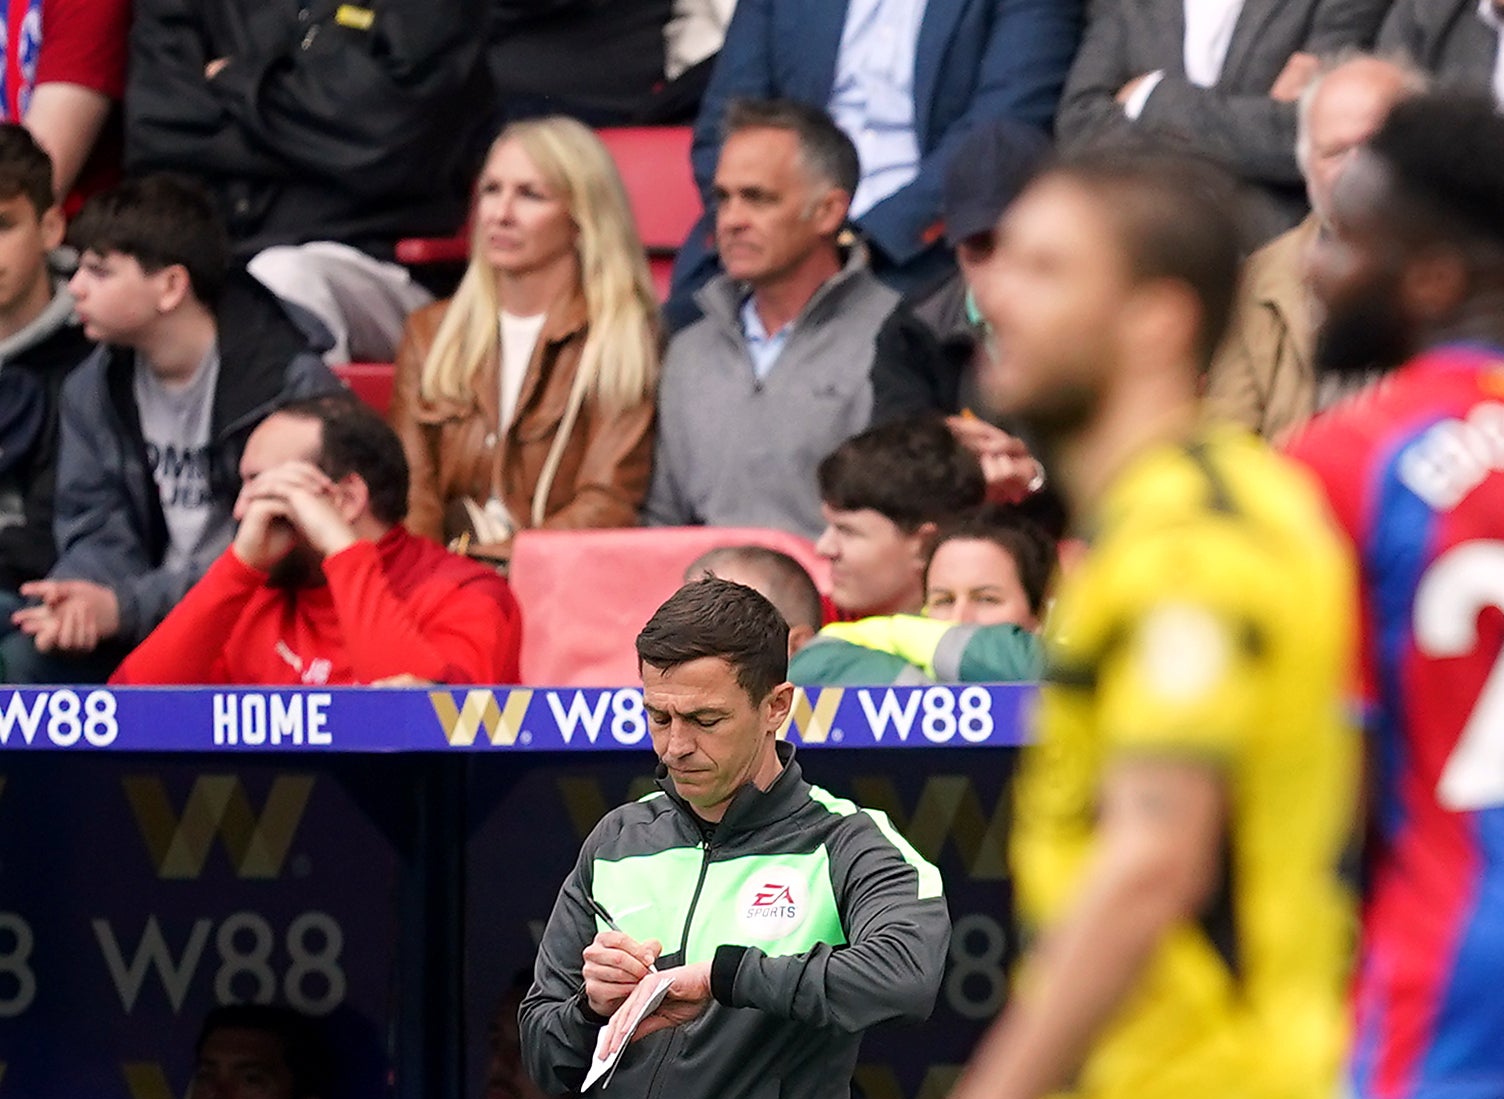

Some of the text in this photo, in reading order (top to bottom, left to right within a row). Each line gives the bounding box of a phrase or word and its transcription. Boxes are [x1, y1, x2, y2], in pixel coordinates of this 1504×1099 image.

[0, 689, 118, 747] W88
[212, 692, 333, 746] HOME
[546, 688, 648, 745] W8
[857, 686, 995, 743] W88
[746, 906, 796, 919] SPORTS
[752, 883, 795, 906] EA
[91, 910, 348, 1018] W88
